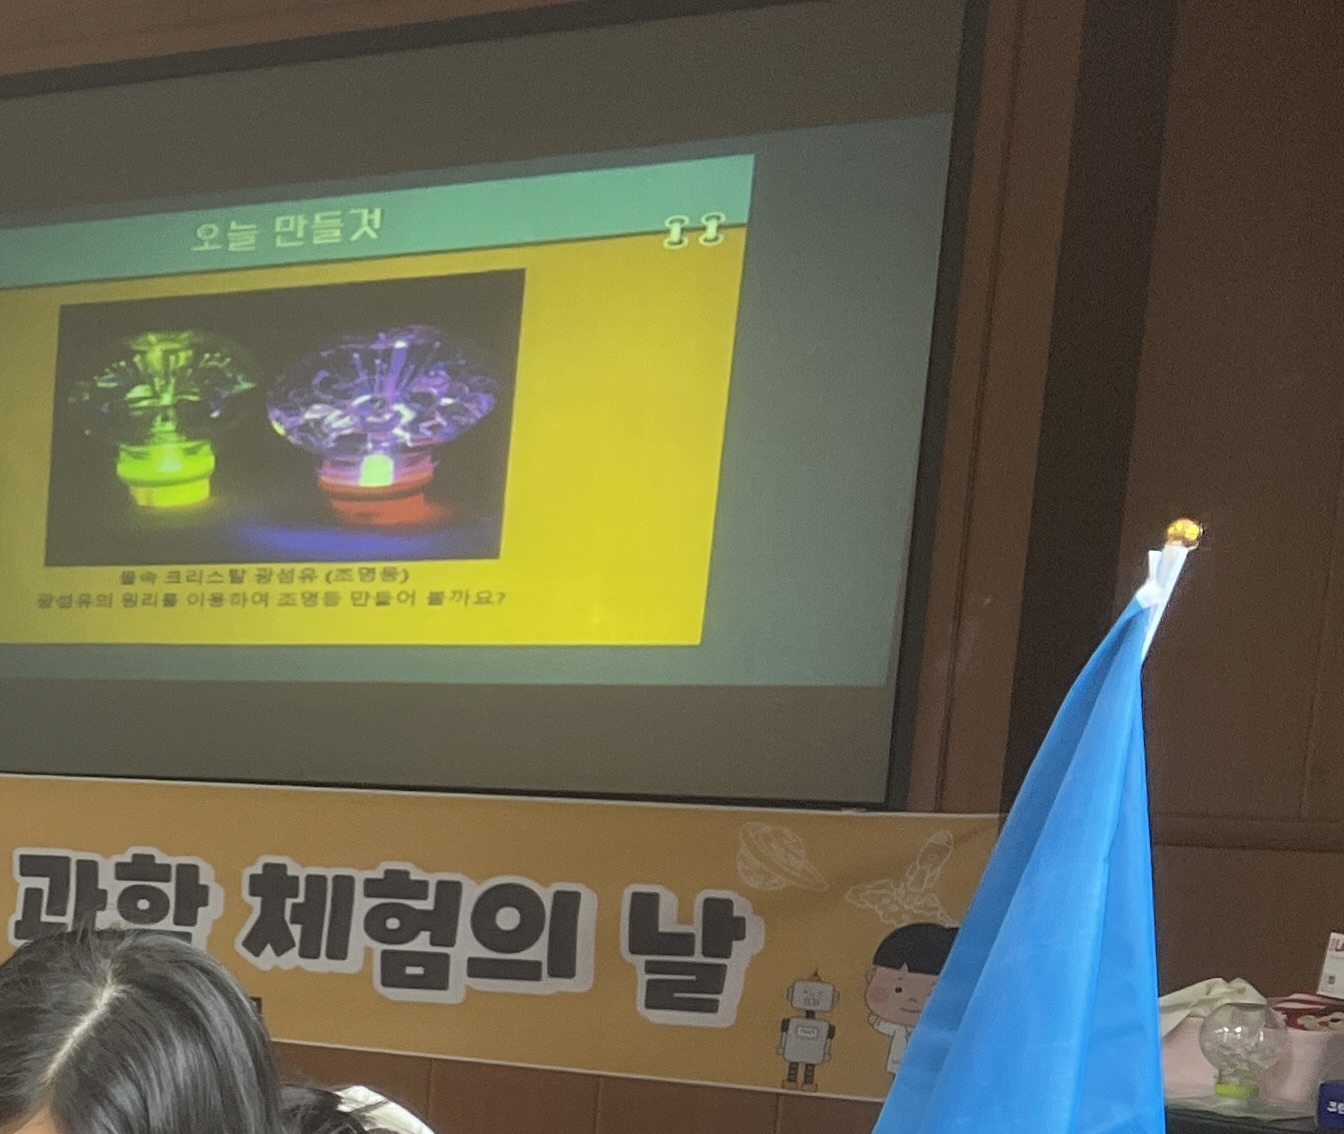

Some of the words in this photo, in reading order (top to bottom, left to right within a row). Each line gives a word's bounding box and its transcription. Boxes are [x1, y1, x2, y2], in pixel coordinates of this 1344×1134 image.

[191, 219, 259, 252] 오늘
[274, 207, 382, 248] 만들것
[120, 570, 158, 586] 물속
[164, 568, 246, 586] 크리스탈
[254, 567, 318, 585] 광섬유
[37, 592, 113, 610] 광섬유의
[121, 592, 178, 609] 원리를
[186, 591, 270, 610] 이용하여
[350, 590, 417, 608] 만들어
[427, 589, 506, 608] 볼까요?
[13, 853, 210, 944] 과학
[240, 861, 583, 991] 체험의
[627, 891, 747, 1014] 날
